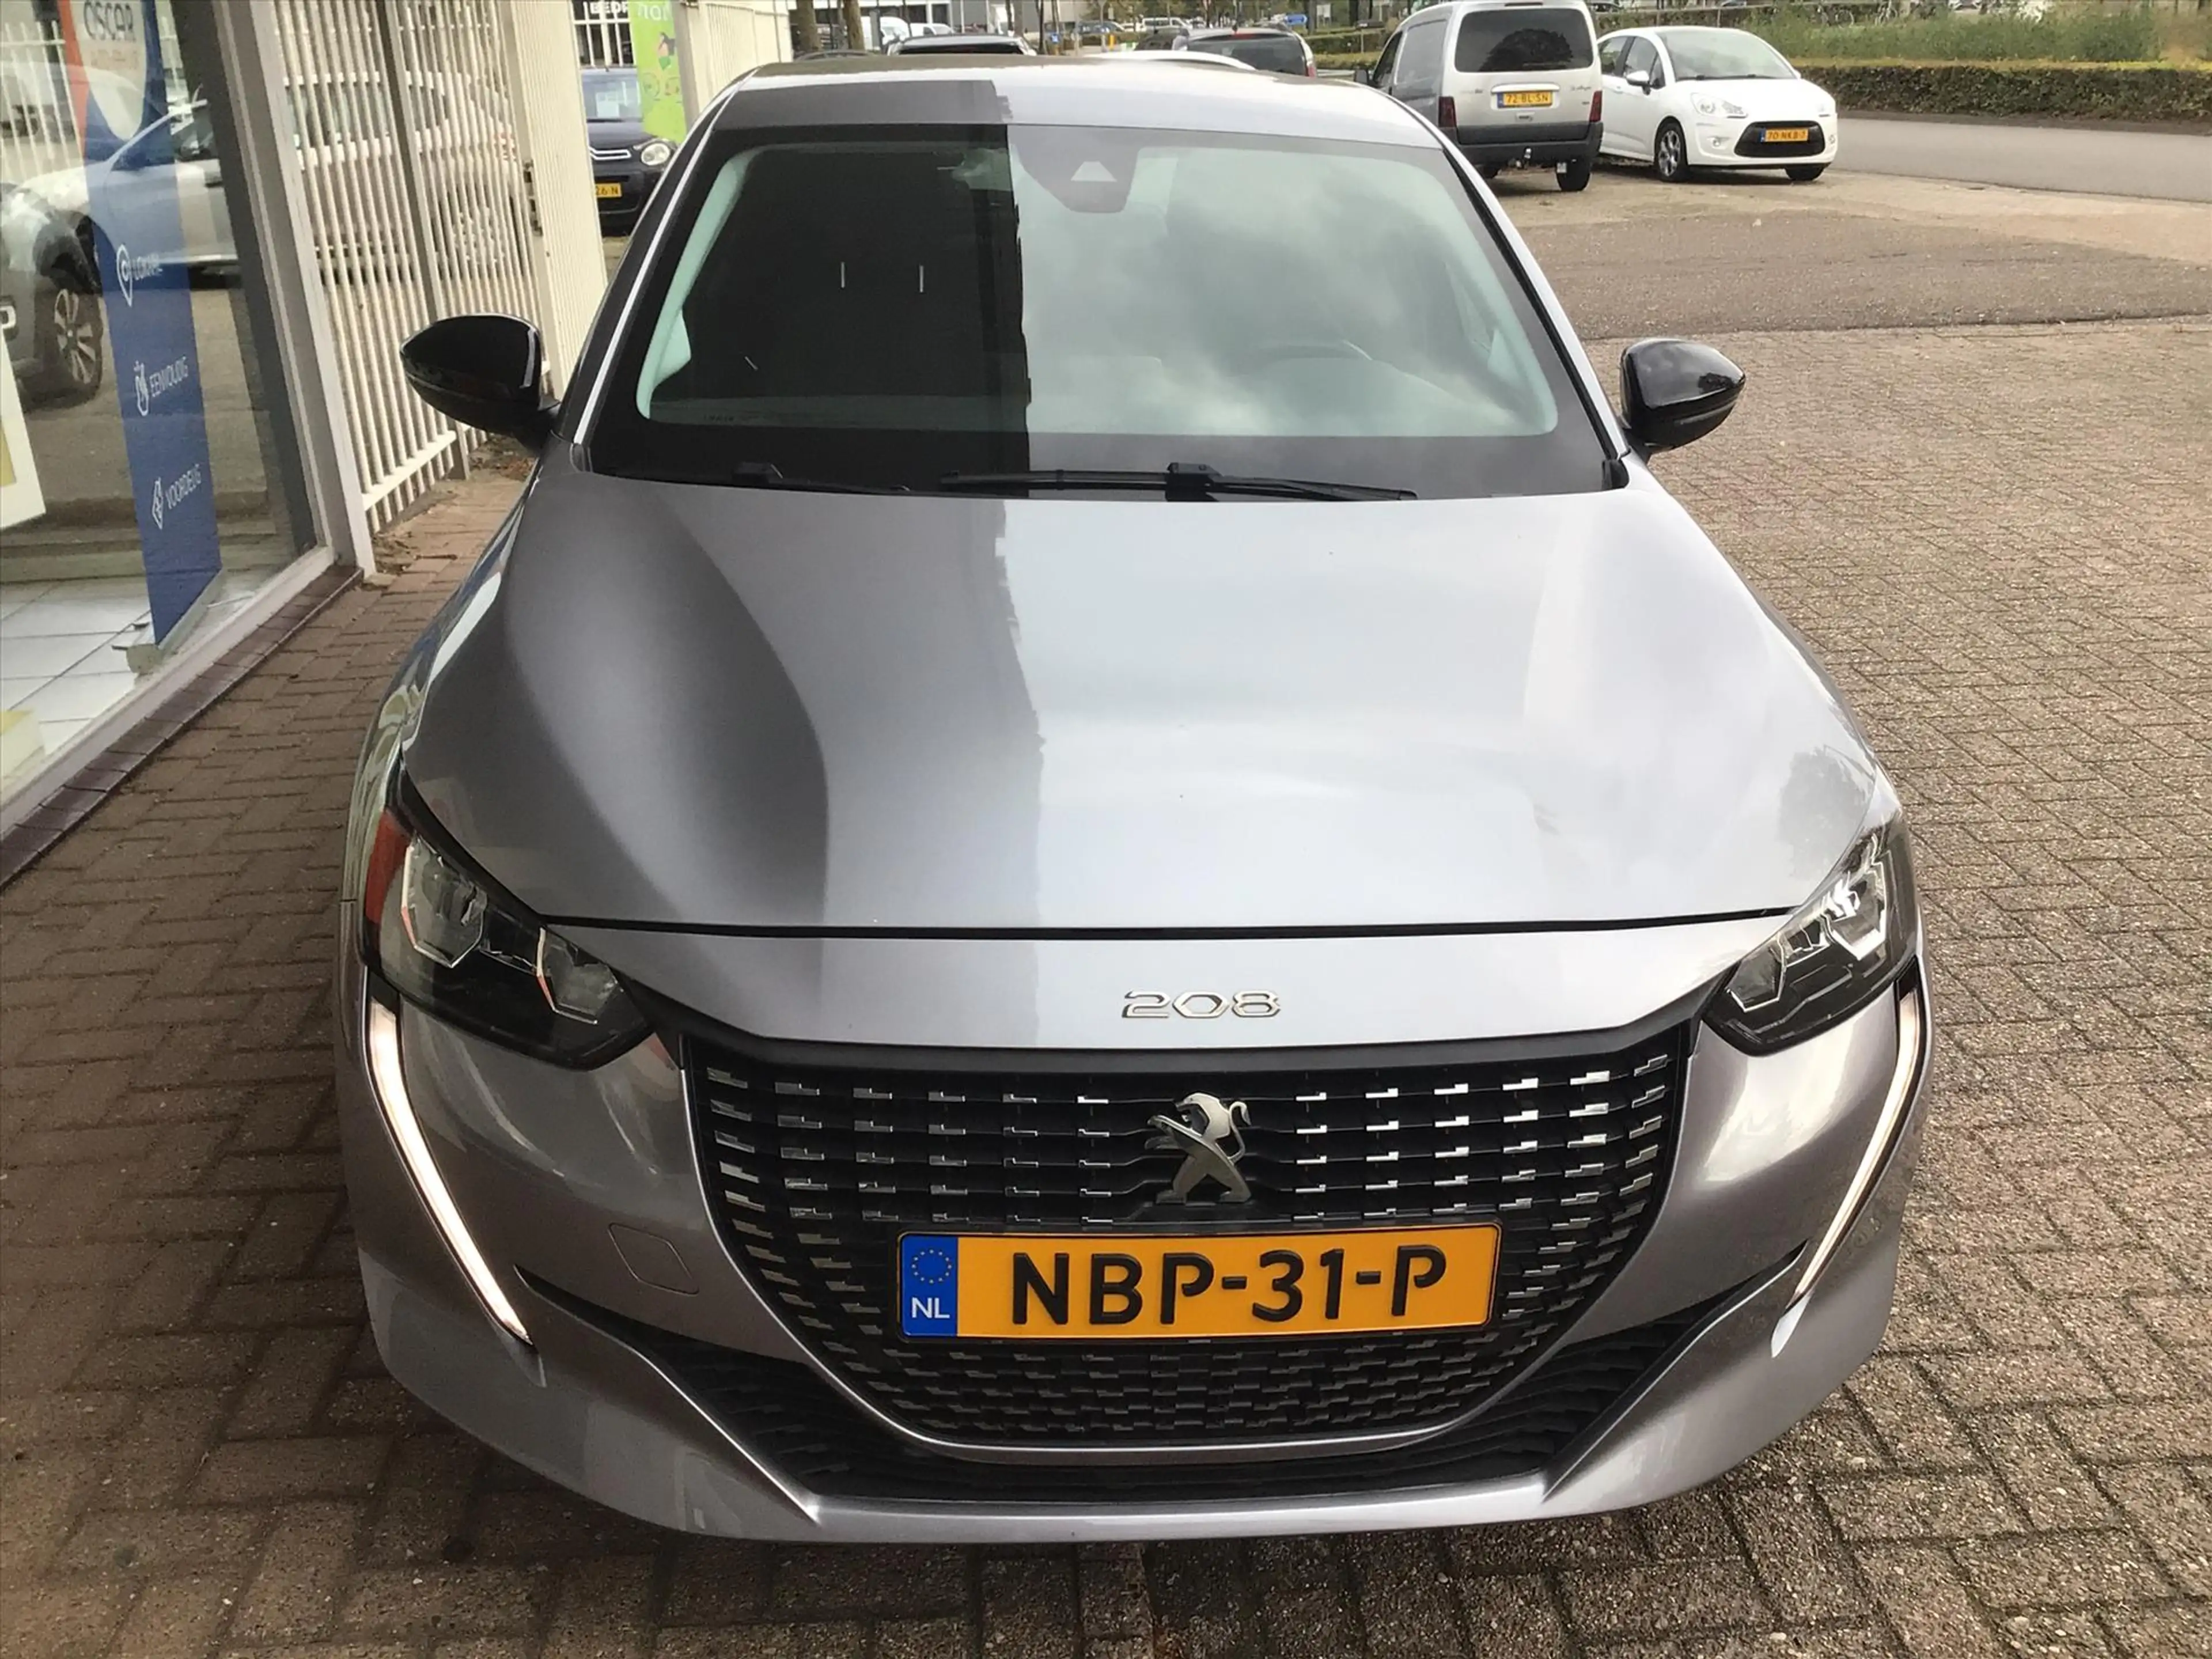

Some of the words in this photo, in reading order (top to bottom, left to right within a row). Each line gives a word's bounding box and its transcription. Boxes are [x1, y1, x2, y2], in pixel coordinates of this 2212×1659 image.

[83, 2, 137, 42] OSCAR
[1122, 990, 1281, 1018] 208
[911, 1297, 950, 1320] NL
[1012, 1245, 1447, 1325] NBP-31-P
